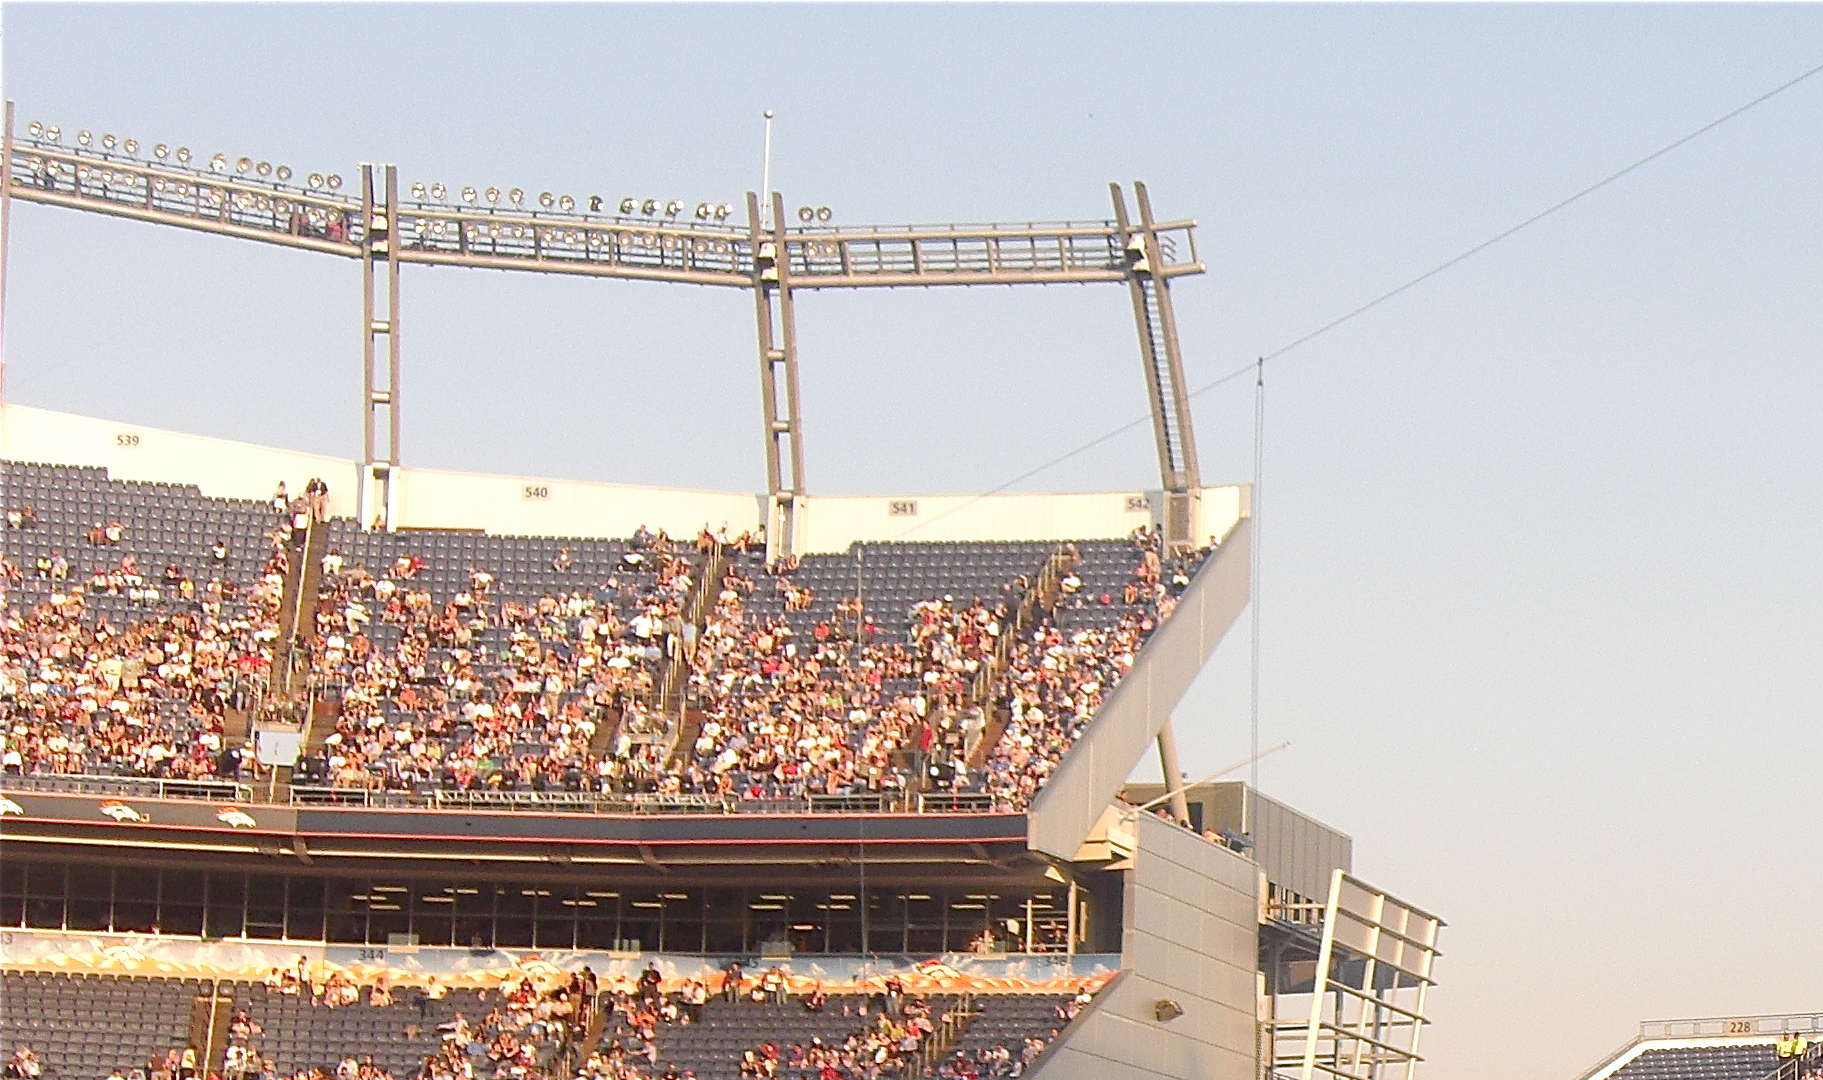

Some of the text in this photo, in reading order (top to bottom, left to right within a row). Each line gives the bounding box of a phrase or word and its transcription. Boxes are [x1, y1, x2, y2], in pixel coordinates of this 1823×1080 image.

[117, 434, 140, 446] 539
[525, 486, 548, 498] 540
[893, 502, 914, 514] 541
[1730, 1021, 1751, 1033] 228
